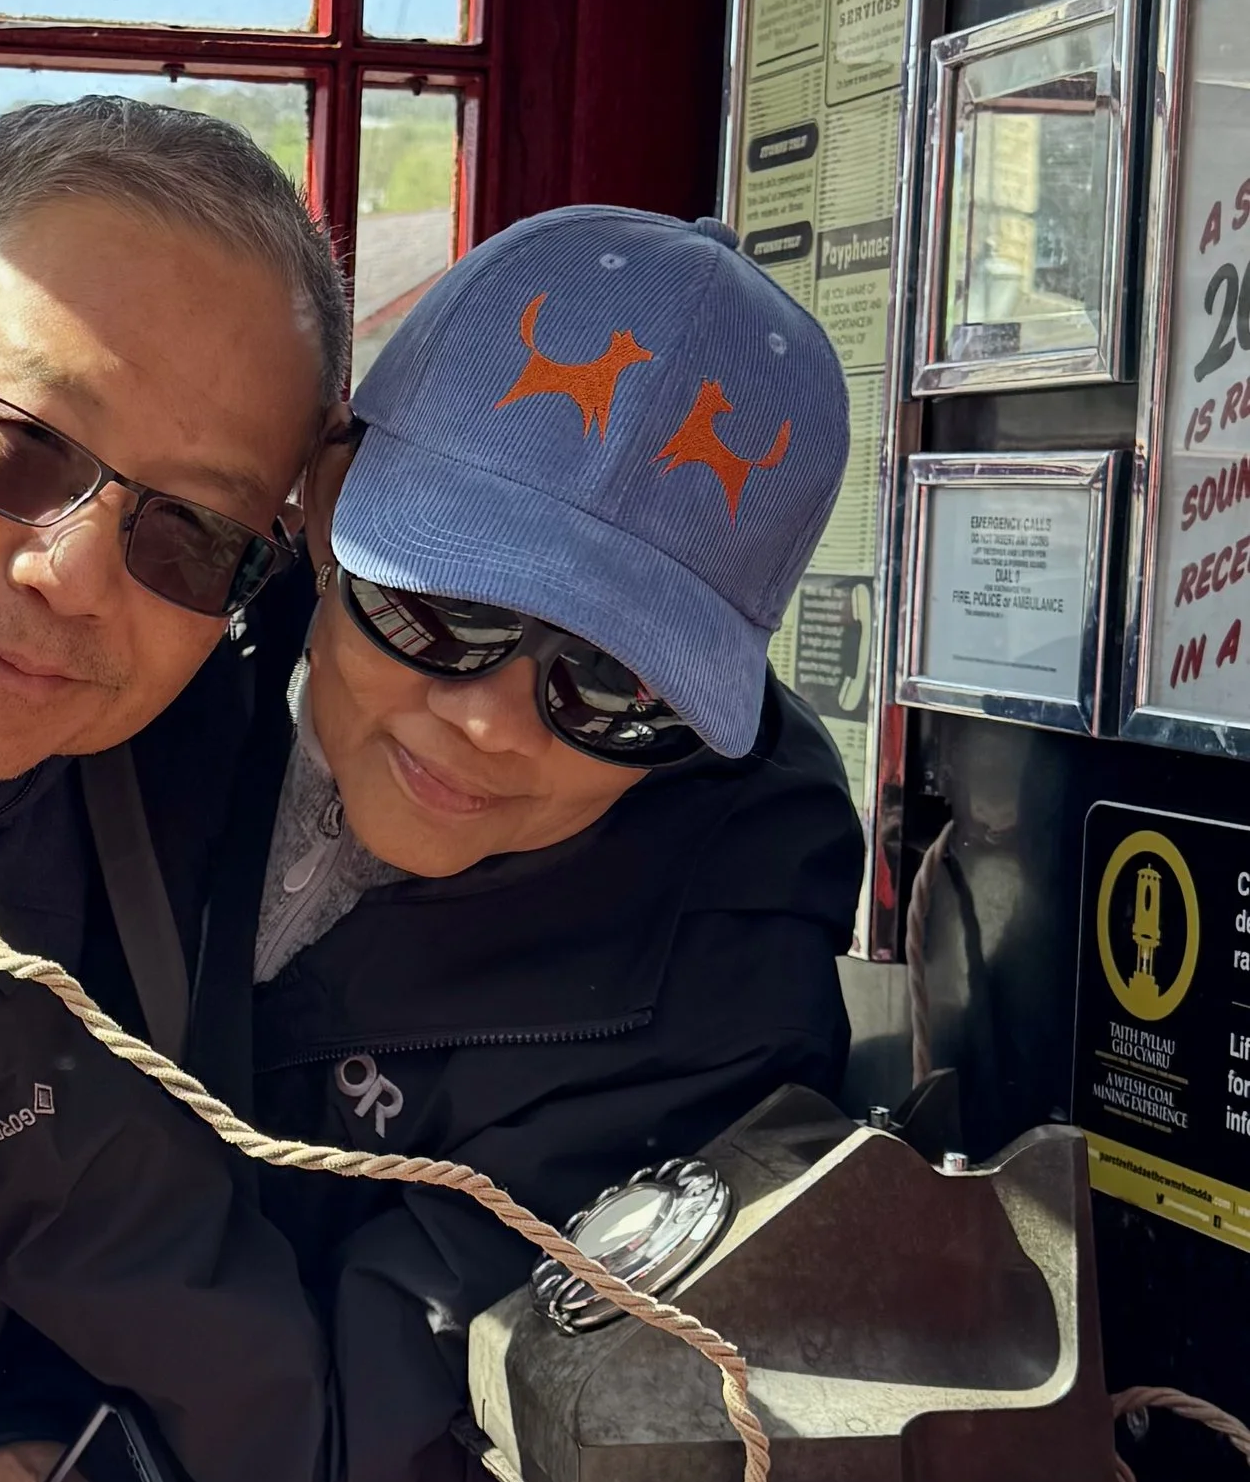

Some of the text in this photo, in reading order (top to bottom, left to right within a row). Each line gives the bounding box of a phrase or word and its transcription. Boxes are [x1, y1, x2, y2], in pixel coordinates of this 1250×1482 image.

[1199, 201, 1222, 254] A
[821, 233, 890, 271] Payphones
[1184, 397, 1215, 451] IS
[971, 515, 1052, 532] EMERGENCY CALLS
[995, 569, 1013, 583] DIAL
[1174, 533, 1250, 608] RECE
[973, 591, 1001, 608] POLICE
[1002, 597, 1012, 608] or
[1013, 596, 1064, 613] AMBULANCE
[1170, 618, 1241, 690] IN A
[1109, 1021, 1176, 1055] TAITH PYLLAU
[1111, 1038, 1133, 1056] GLO
[1134, 1045, 1170, 1069] CYMRU
[334, 1053, 404, 1139] OR
[1092, 1082, 1130, 1108] MINING
[1131, 1095, 1189, 1129] EXPERIENCE
[1106, 1071, 1175, 1107] A WELSH COAL
